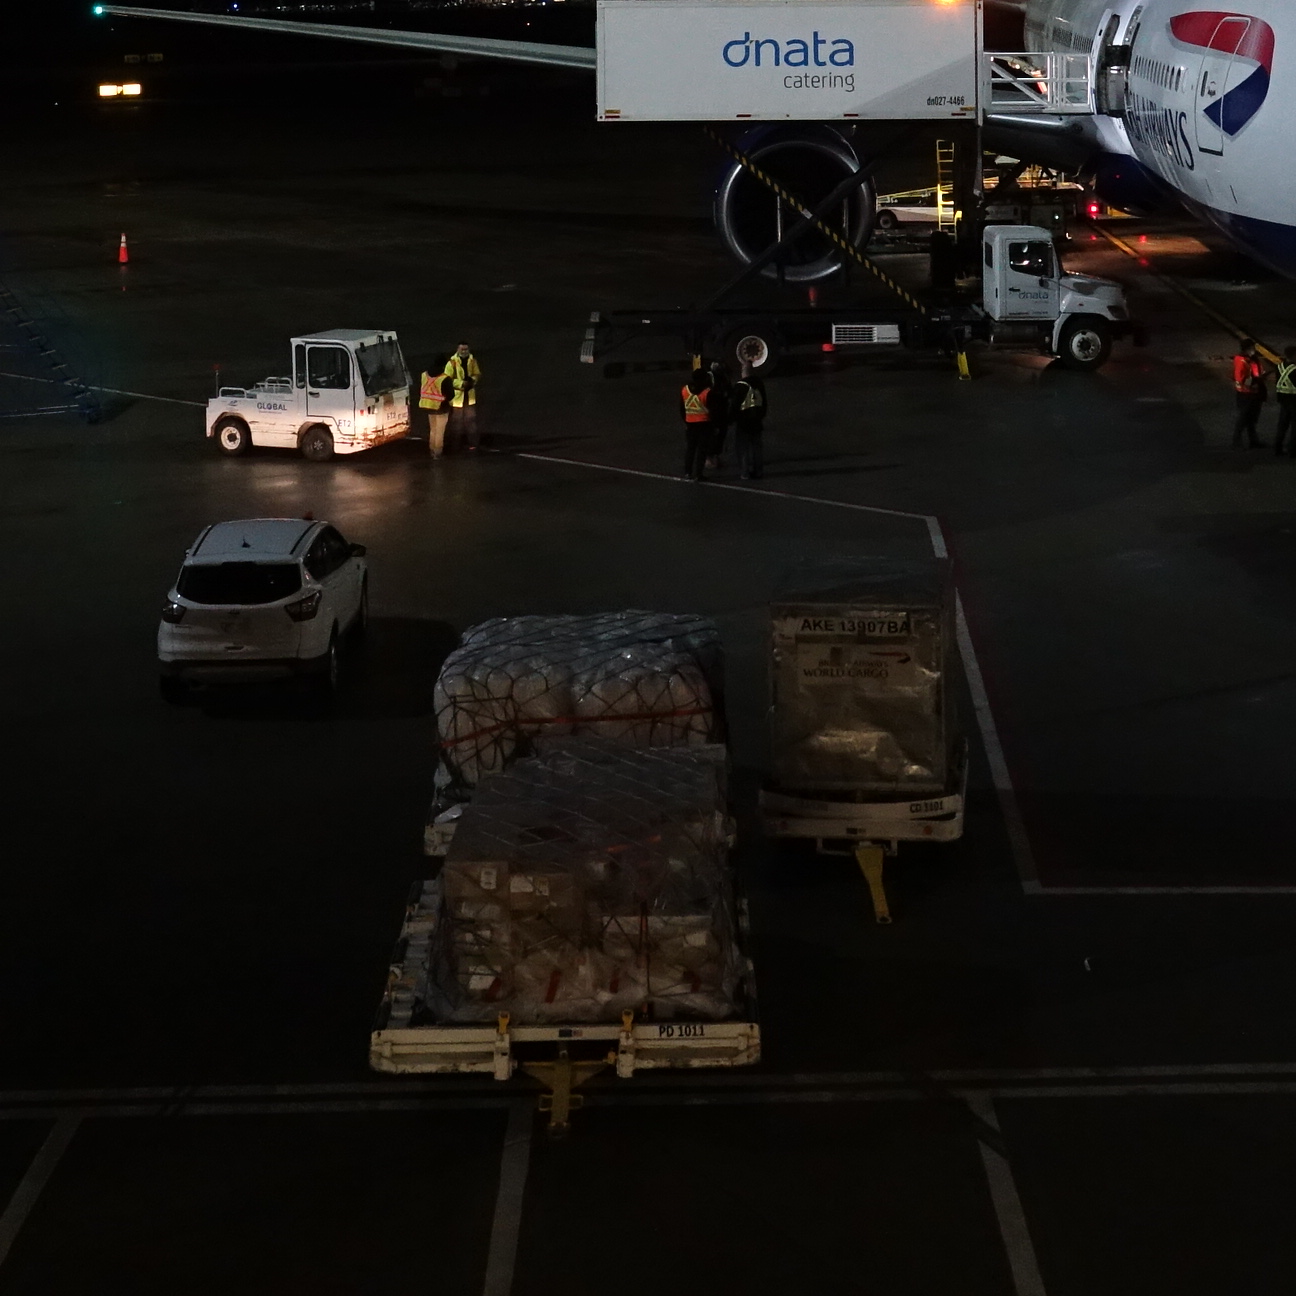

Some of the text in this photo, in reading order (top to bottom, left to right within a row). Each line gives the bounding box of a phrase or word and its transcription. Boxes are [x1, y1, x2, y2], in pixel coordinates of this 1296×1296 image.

[722, 31, 854, 67] dnata
[783, 72, 855, 92] catering
[1018, 291, 1049, 300] dnata
[257, 402, 287, 411] GLOBAL
[801, 618, 834, 632] AKE
[803, 668, 889, 678] WORLD CARGO
[659, 1025, 705, 1037] PD 1011
